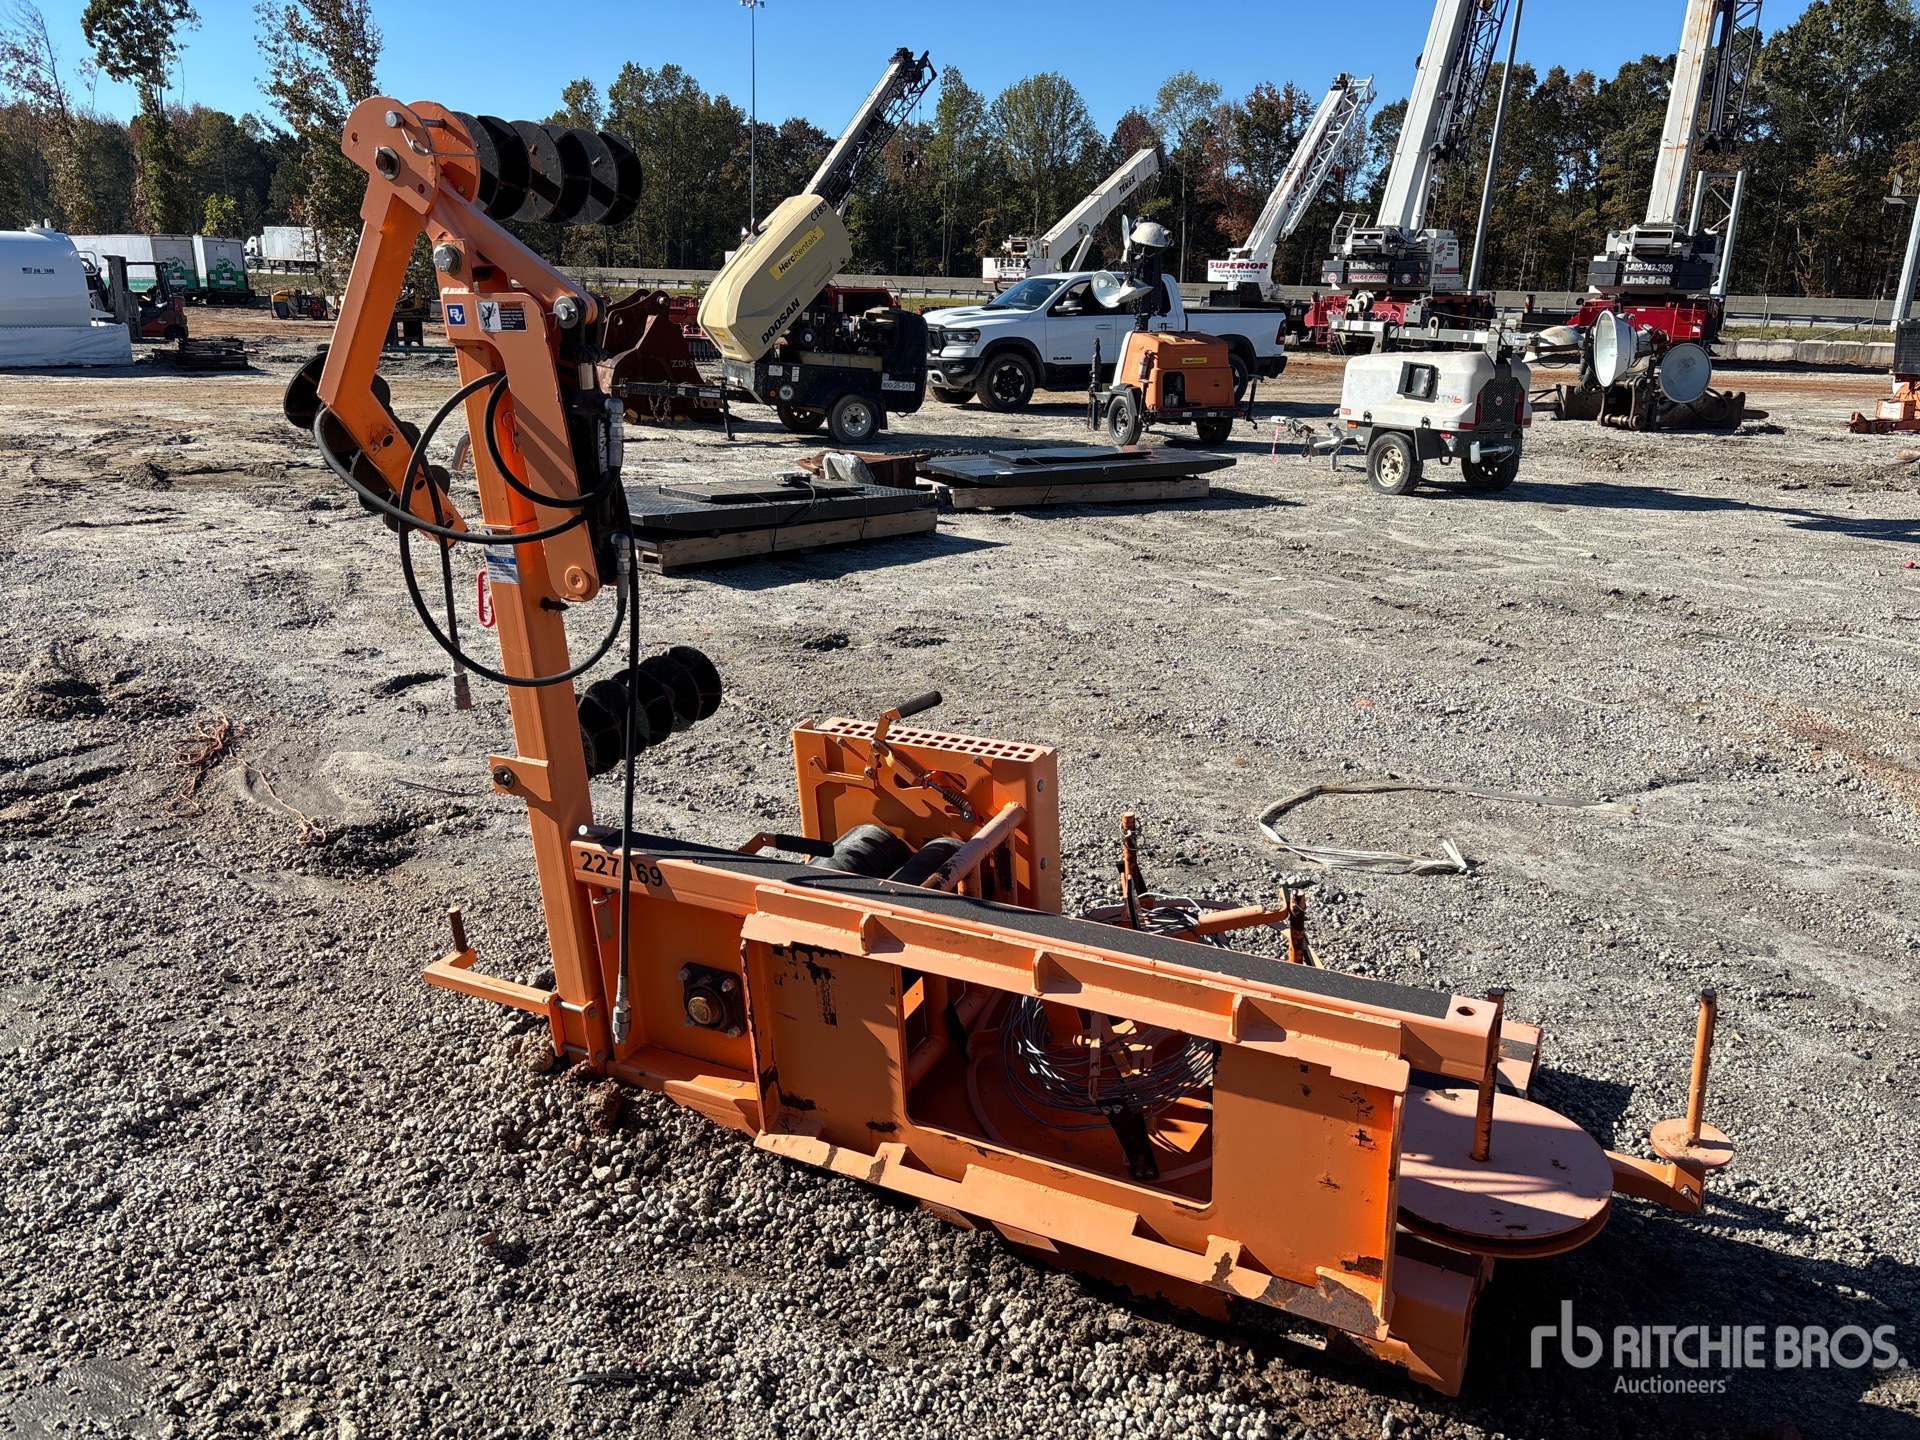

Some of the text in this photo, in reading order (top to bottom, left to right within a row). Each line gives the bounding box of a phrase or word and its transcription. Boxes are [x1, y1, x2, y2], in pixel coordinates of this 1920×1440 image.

[1119, 174, 1136, 194] TEREX
[810, 202, 828, 221] C185
[778, 234, 818, 273] HercRentals
[994, 258, 1031, 269] TEREX
[1350, 261, 1389, 270] Link-Belt
[1623, 276, 1671, 285] Link-Belt
[761, 297, 801, 345] DOOSAN
[580, 851, 663, 887] 22769
